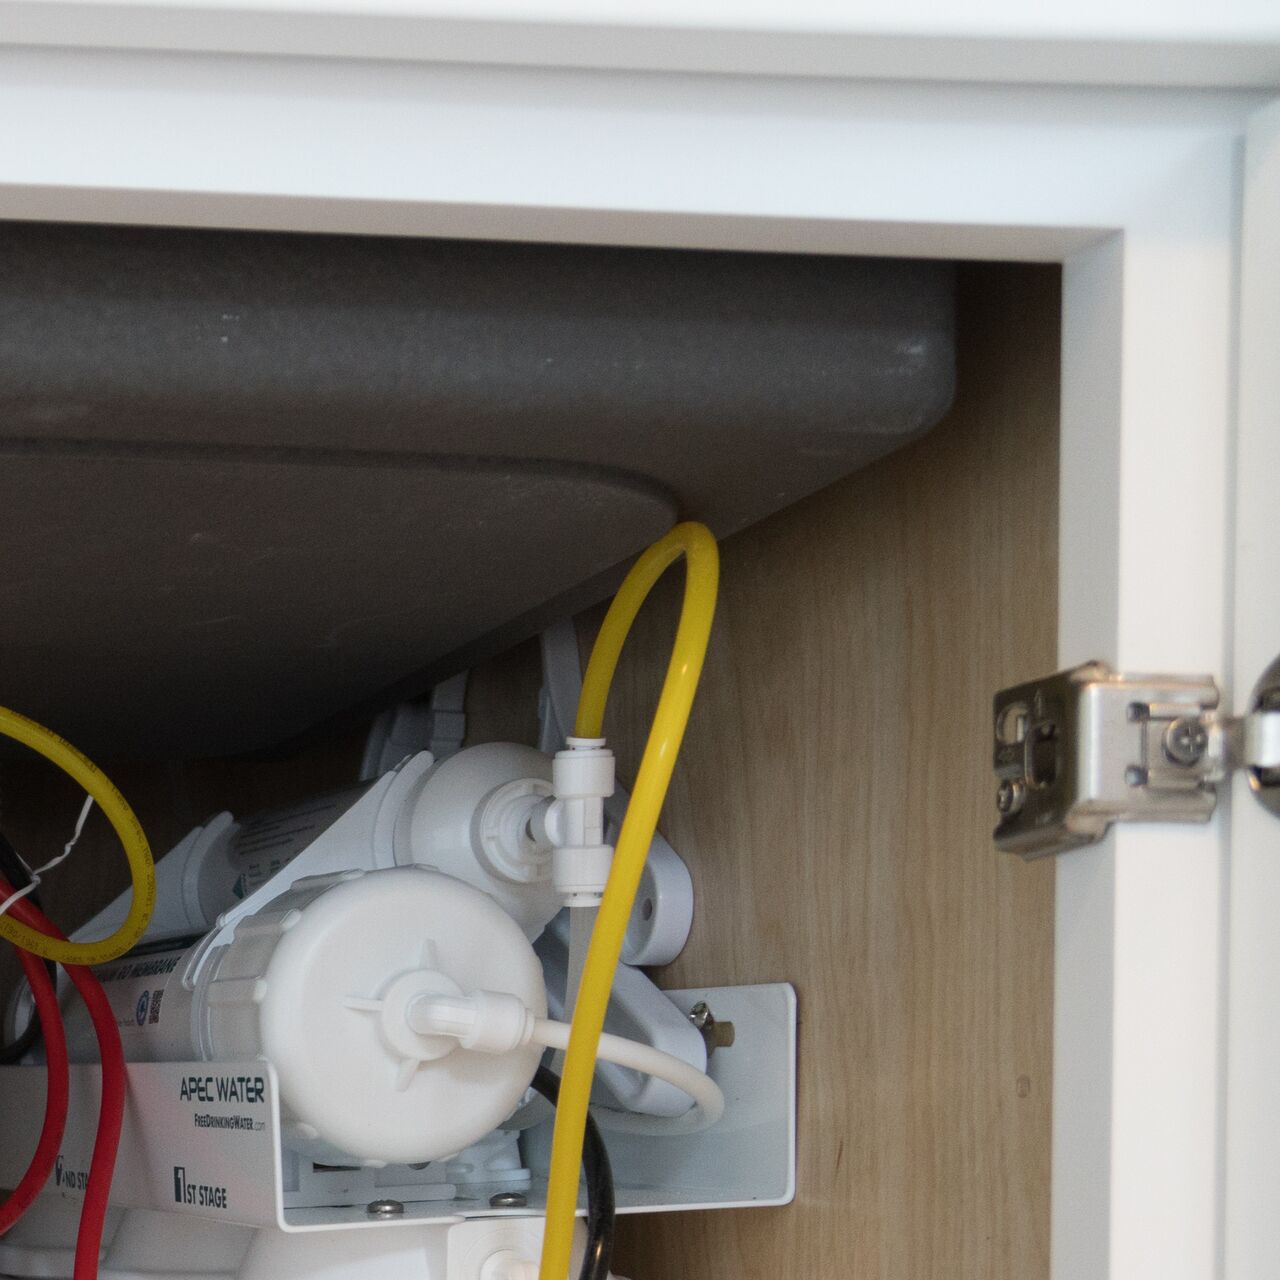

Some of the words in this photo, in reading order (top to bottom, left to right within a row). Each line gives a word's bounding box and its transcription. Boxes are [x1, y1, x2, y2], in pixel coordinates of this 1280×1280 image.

[180, 1076, 214, 1102] APEC
[216, 1077, 265, 1103] WATER
[173, 1166, 196, 1205] 1ST
[199, 1185, 227, 1208] STAGE
